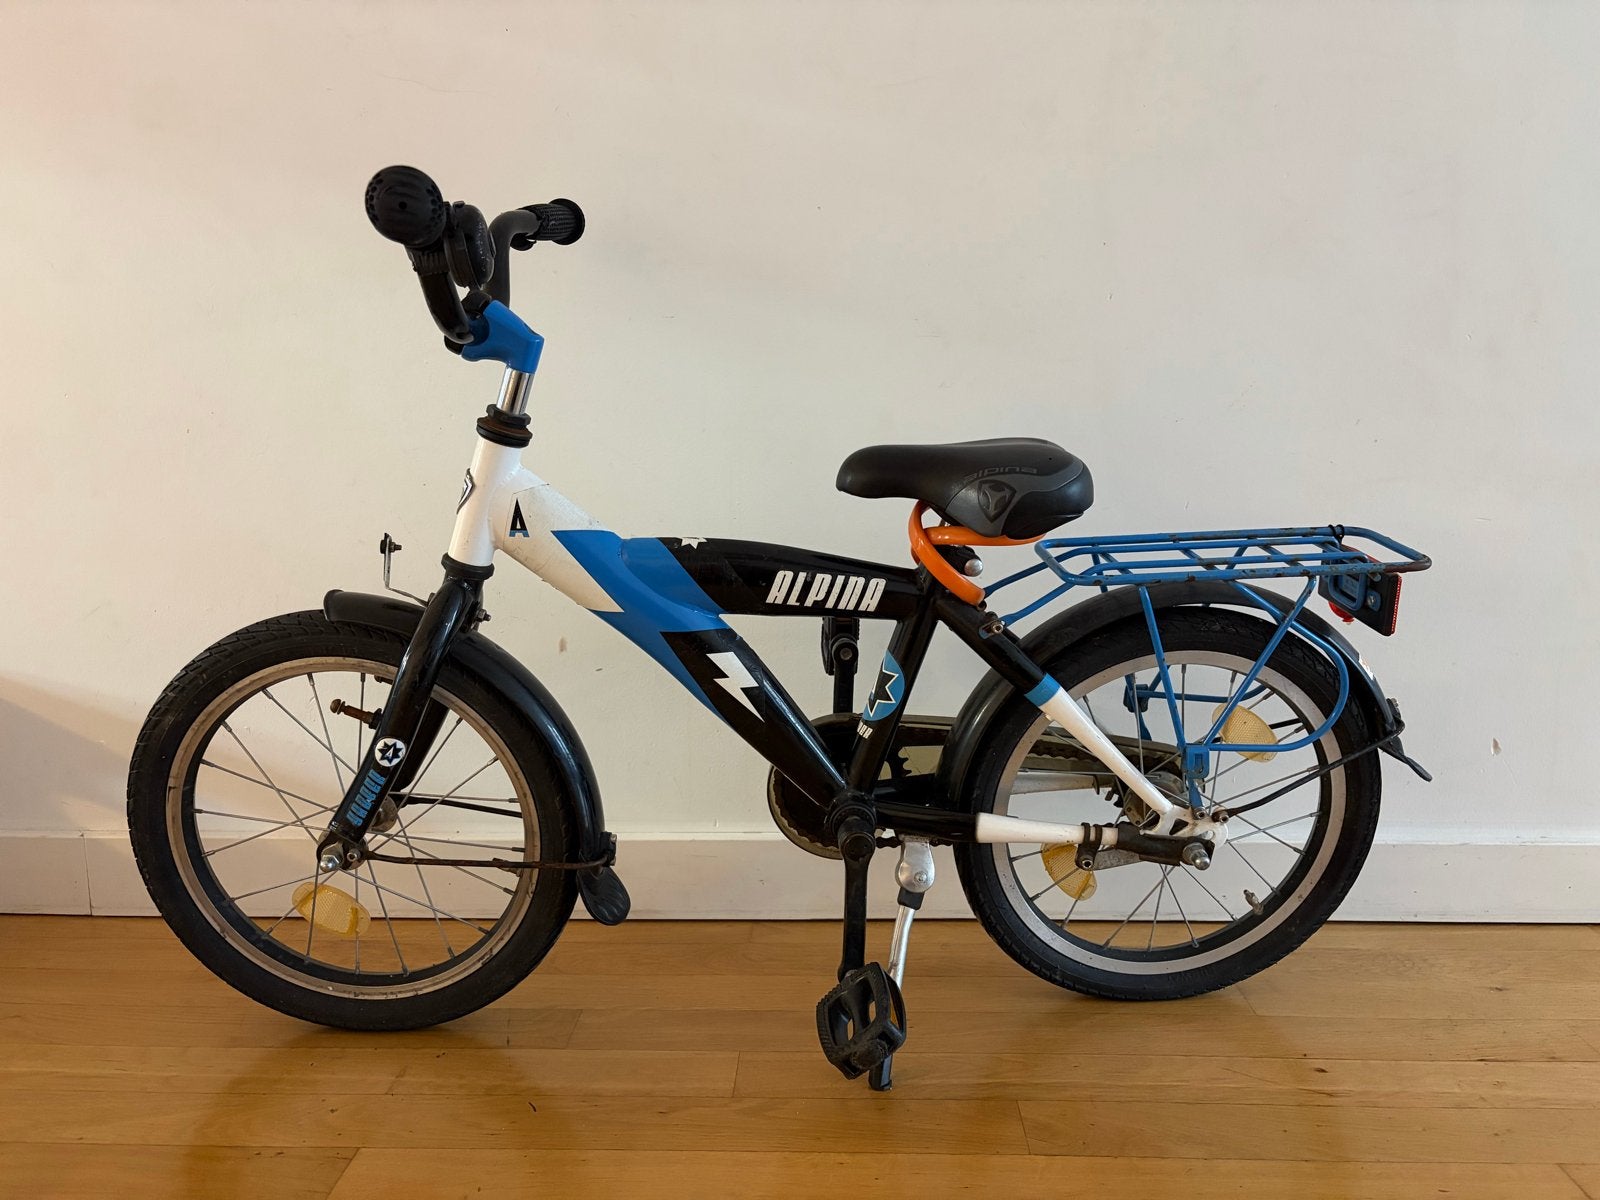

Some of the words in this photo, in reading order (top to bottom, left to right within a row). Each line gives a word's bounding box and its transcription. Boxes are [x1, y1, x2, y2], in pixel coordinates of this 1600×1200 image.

[962, 466, 1038, 483] alpina
[509, 498, 530, 538] A
[765, 570, 887, 612] ALPINA
